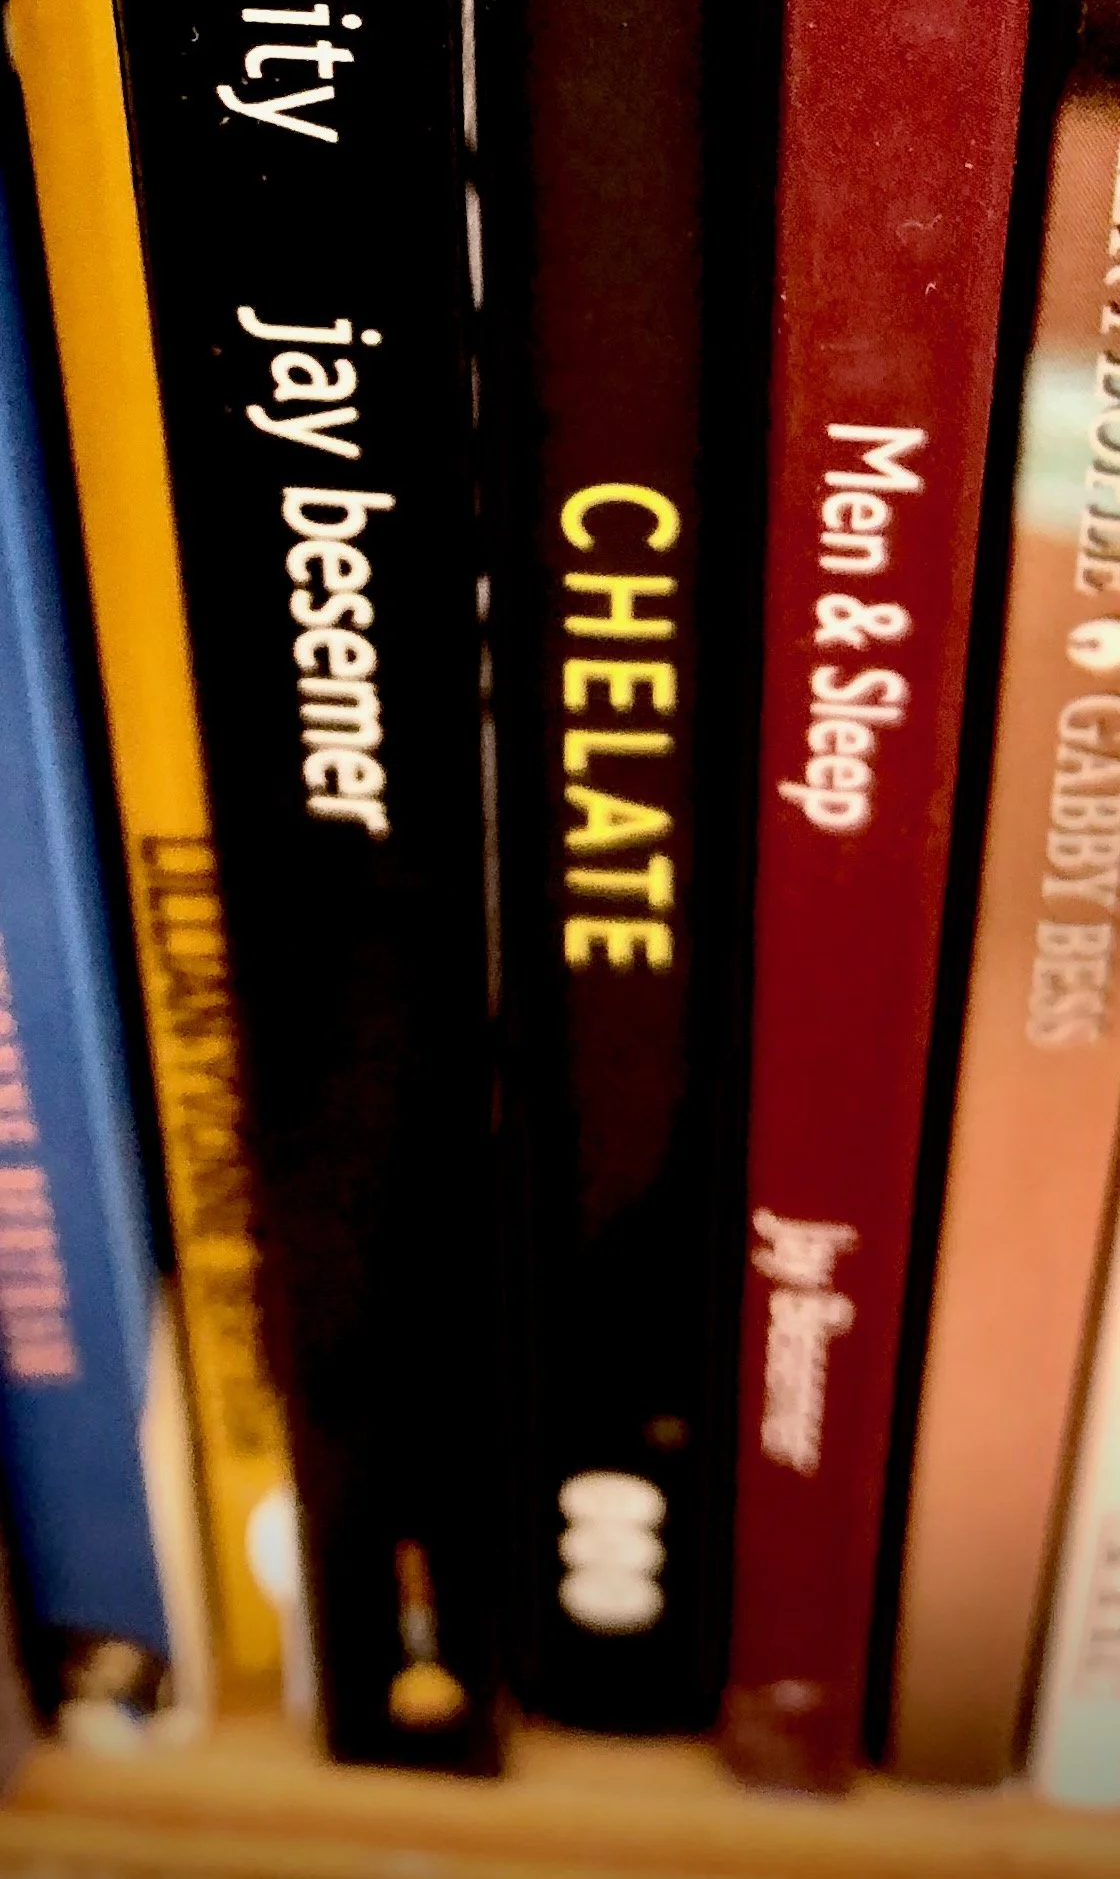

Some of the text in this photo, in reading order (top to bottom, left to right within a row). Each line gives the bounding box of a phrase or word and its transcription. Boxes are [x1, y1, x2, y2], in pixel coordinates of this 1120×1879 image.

[237, 306, 396, 835] jay besemer
[560, 482, 681, 969] CHELATE
[779, 423, 927, 832] Men & Sleep
[1025, 920, 1114, 1048] BESS
[1042, 693, 1120, 913] GABBY
